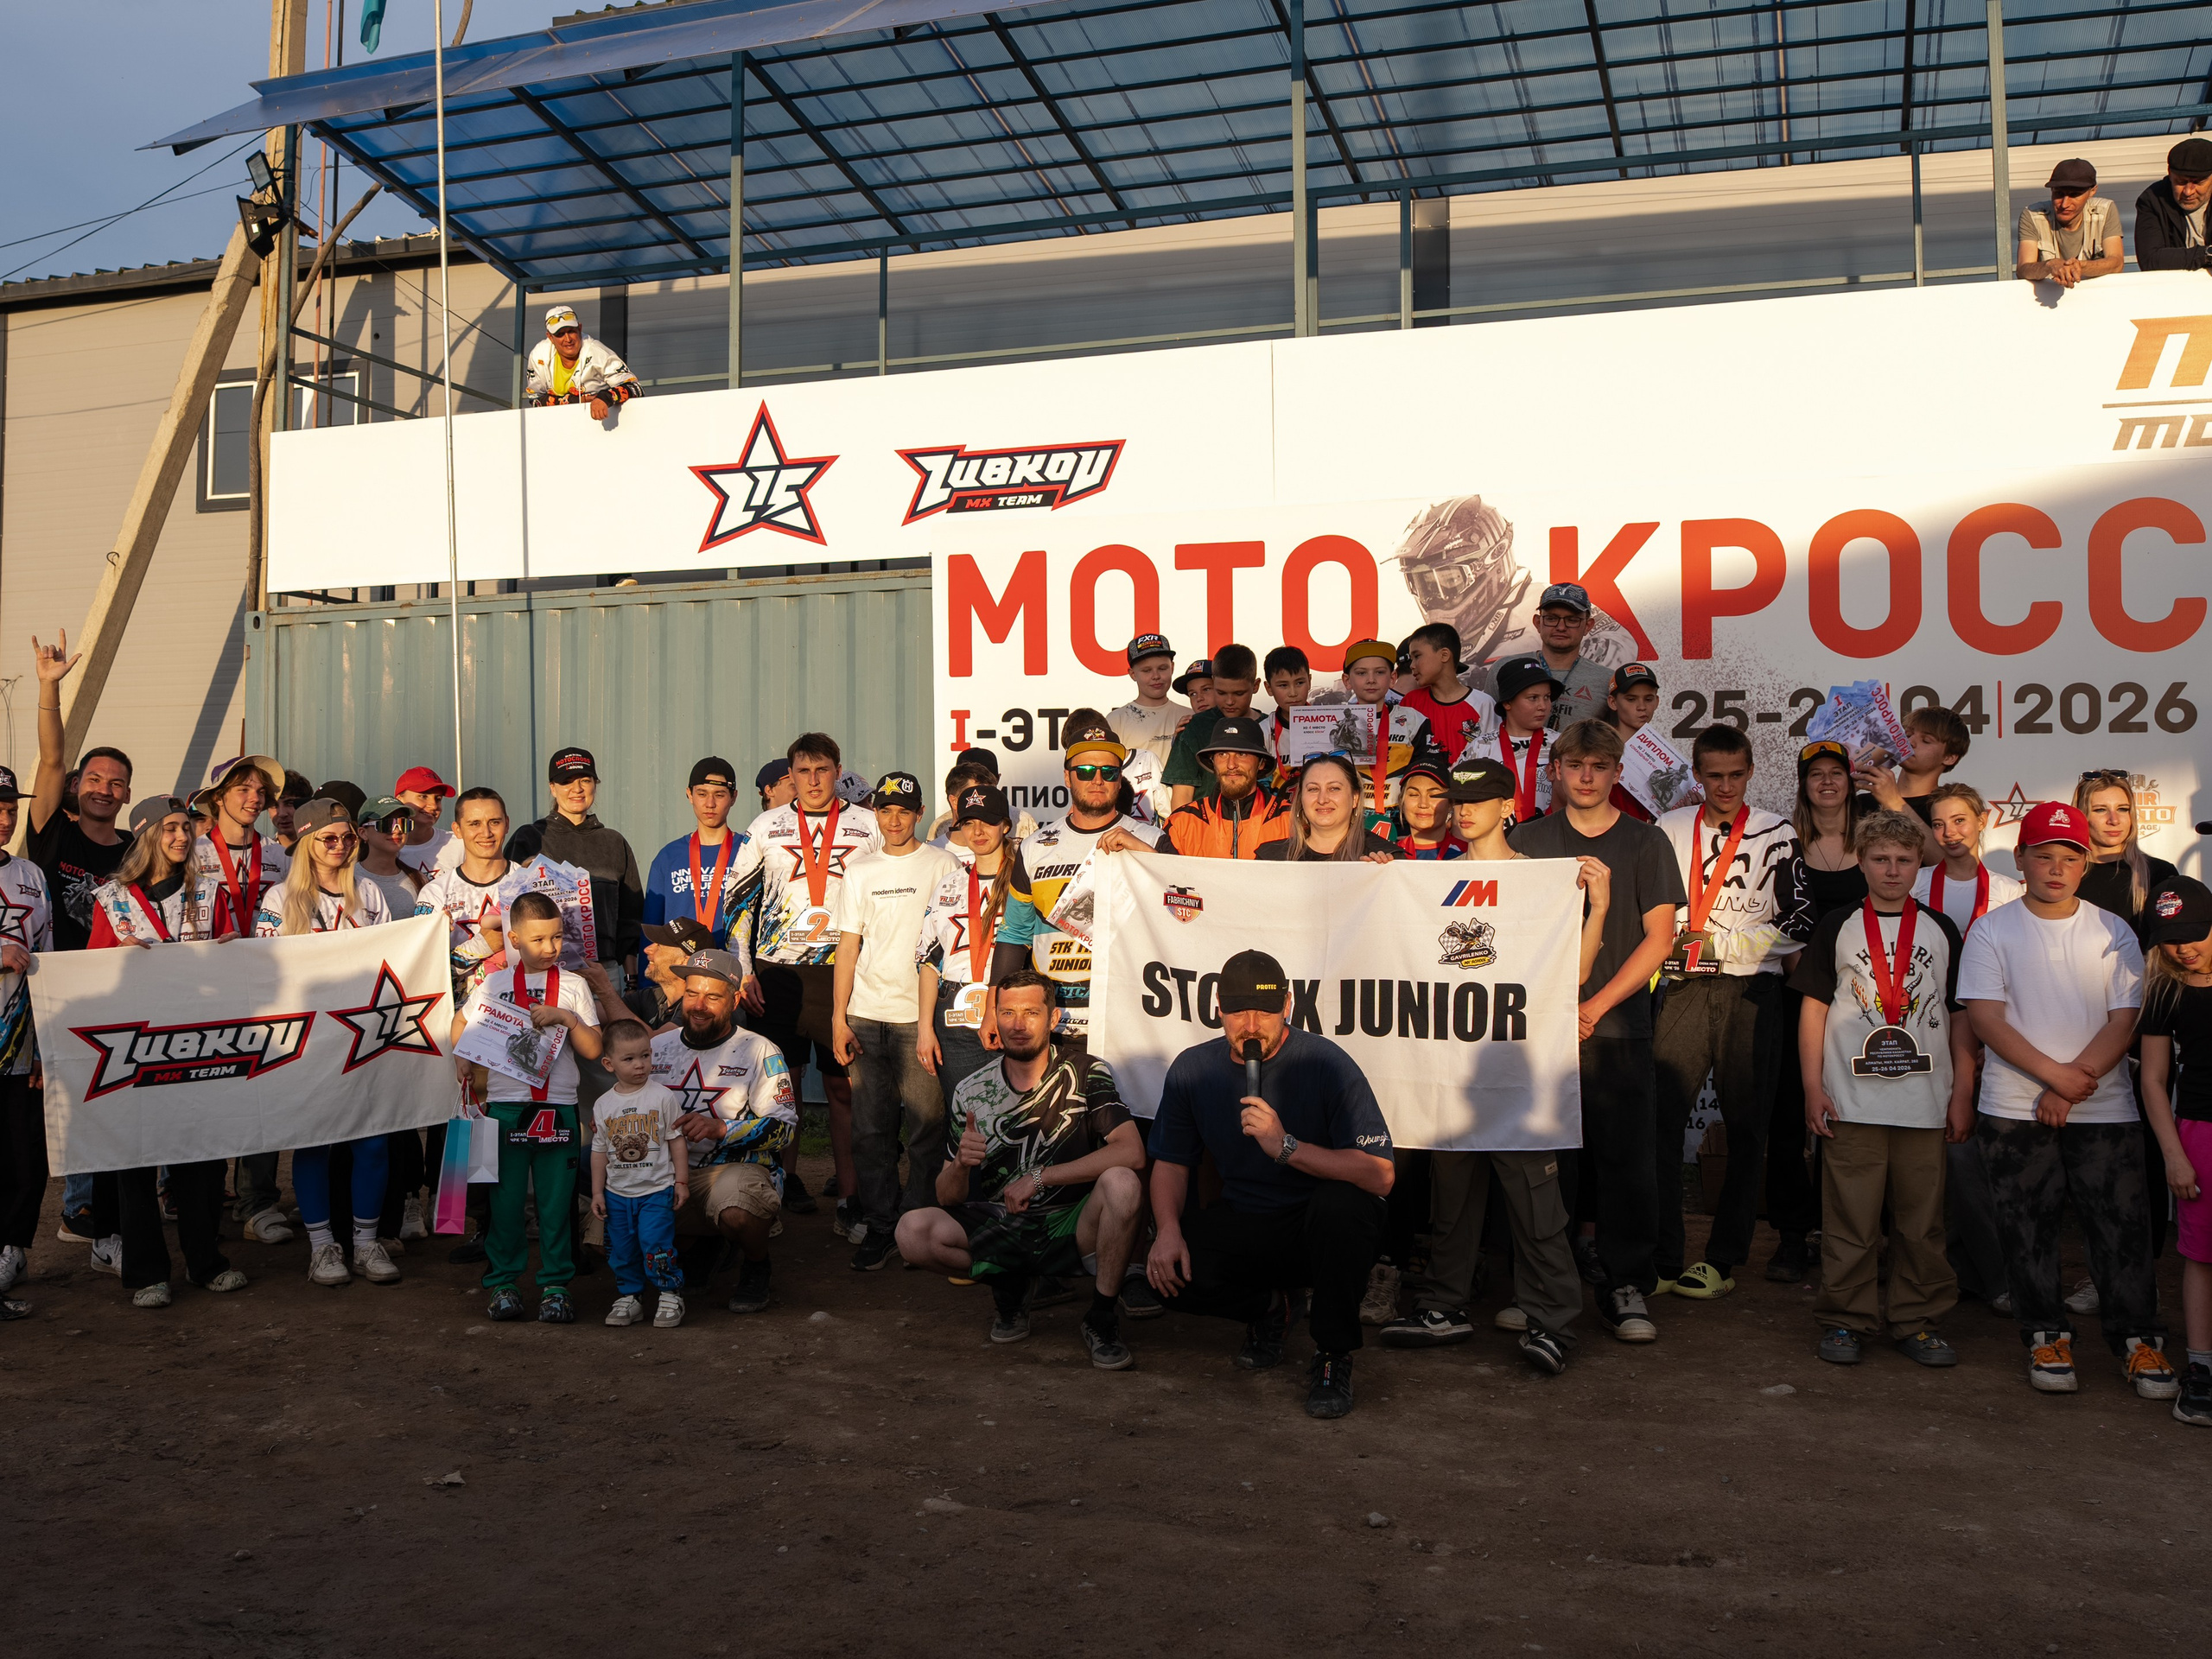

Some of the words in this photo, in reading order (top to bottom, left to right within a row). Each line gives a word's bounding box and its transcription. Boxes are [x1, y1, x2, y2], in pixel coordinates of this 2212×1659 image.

[964, 498, 992, 509] MX
[997, 494, 1043, 506] TEAM
[947, 533, 1380, 678] МОТО
[1548, 495, 2209, 662] КРОСС
[1137, 634, 1159, 645] FXR
[1672, 689, 1827, 739] 25-2
[2013, 681, 2197, 734] 2026
[1833, 702, 1853, 718] ЭТАП
[1871, 687, 1896, 726] КРОСС
[1293, 715, 1338, 723] ГРАМОТА
[950, 708, 1070, 753] I-ЭТ
[1637, 733, 1675, 767] ДИПЛОМ
[1887, 724, 1911, 758] МОТО
[537, 866, 546, 879] I
[1033, 863, 1082, 880] GAVRI
[531, 879, 556, 888] ЭТАП
[672, 883, 689, 893] OF
[894, 887, 917, 895] identity
[577, 879, 593, 923] КРОСС
[1166, 895, 1200, 908] FABRICHNIY
[1177, 907, 1192, 918] STC
[2160, 907, 2176, 917] 38
[806, 912, 830, 942] 2
[1058, 918, 1079, 938] МОТО
[583, 926, 597, 960] МОТО
[1049, 940, 1074, 955] STK
[1048, 957, 1092, 972] JUNIO
[1450, 949, 1489, 961] GAVRILENKO
[1681, 939, 1703, 972] 1
[964, 988, 988, 1023] 3
[1141, 961, 1220, 1029] STO
[1334, 978, 1528, 1042] JUNIOR
[477, 1003, 524, 1028] ГРАМОТА
[537, 1053, 554, 1078] МОТО
[550, 1027, 565, 1056] КРОСС
[154, 1070, 182, 1083] MX
[189, 1064, 238, 1079] TEAM
[526, 1109, 556, 1138] 4
